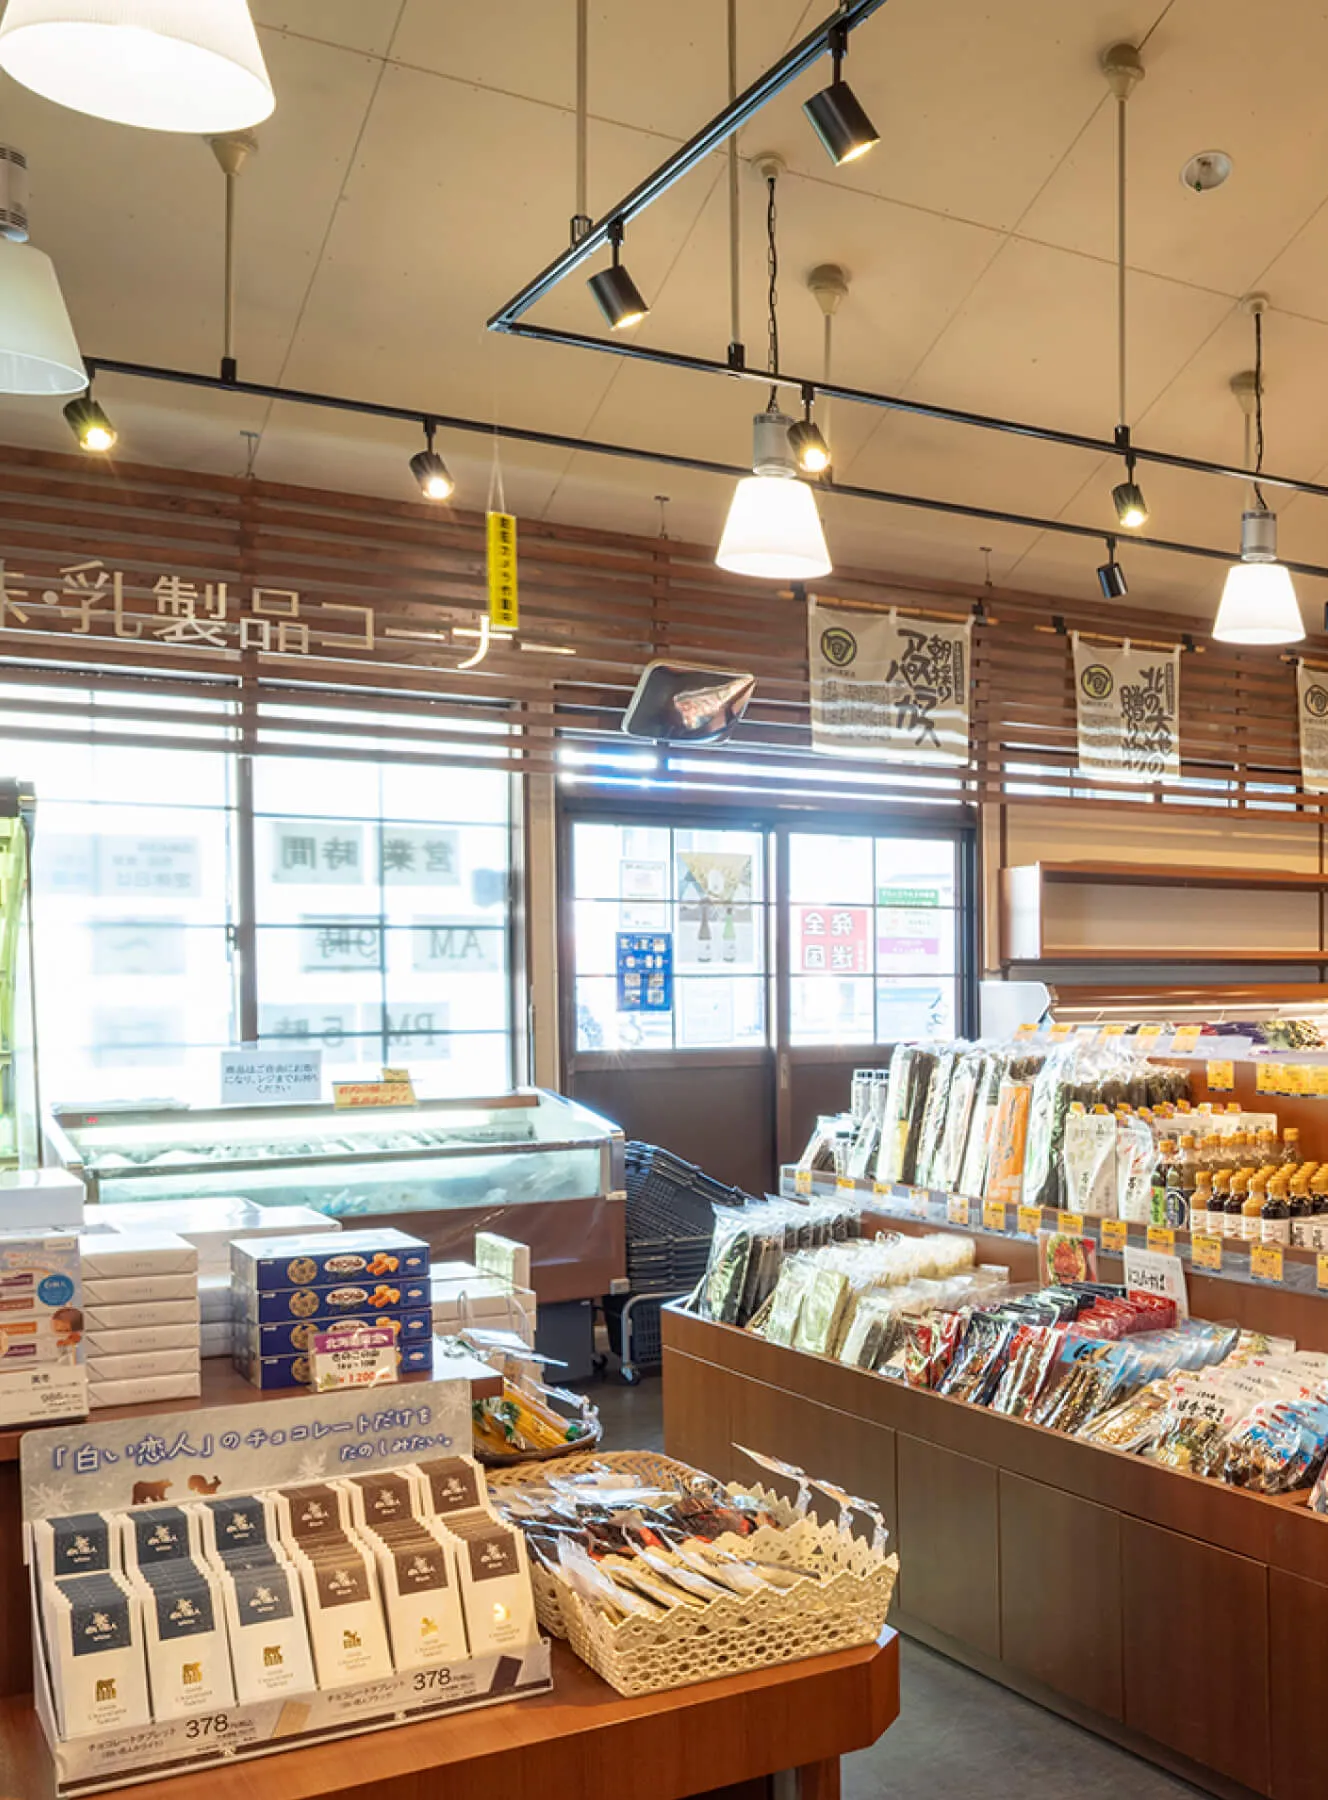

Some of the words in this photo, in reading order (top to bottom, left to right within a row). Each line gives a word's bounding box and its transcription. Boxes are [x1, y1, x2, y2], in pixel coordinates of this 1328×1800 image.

[53, 1406, 432, 1473] 「白い恋人」のチョコレートだけを
[340, 1434, 453, 1461] たのしみたい。
[413, 1666, 451, 1691] 378
[184, 1713, 229, 1738] 378
